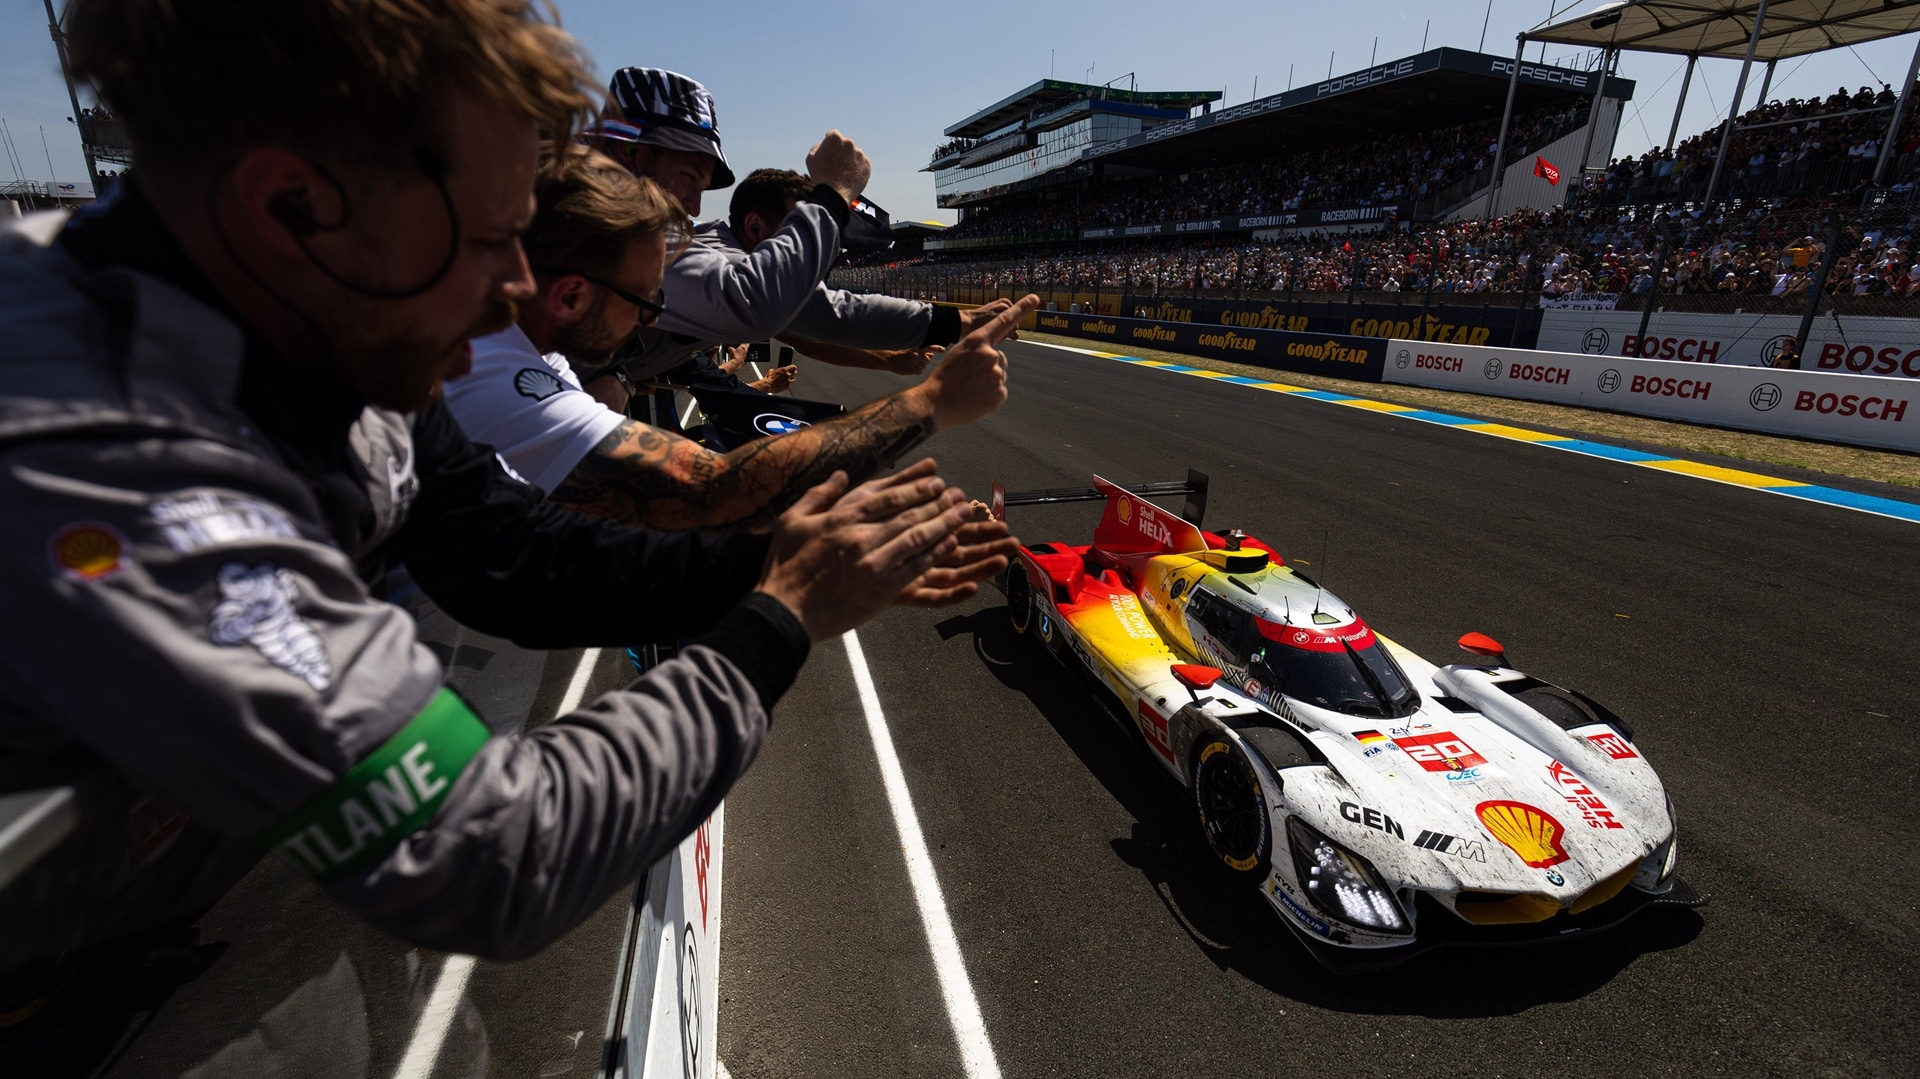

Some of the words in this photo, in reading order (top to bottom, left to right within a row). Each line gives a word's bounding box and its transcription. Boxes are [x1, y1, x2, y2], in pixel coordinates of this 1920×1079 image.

[1317, 59, 1414, 96] PORSCHE
[1491, 60, 1589, 88] PORSCHE
[1215, 97, 1281, 123] PORSCHE
[1146, 120, 1197, 141] PORSCHE
[1089, 139, 1128, 156] PORSCHE
[1175, 222, 1199, 232] RACBORN
[1239, 217, 1268, 228] RACEBORN
[1321, 209, 1360, 223] RACEBORN
[1082, 320, 1116, 335] GOODYEAR
[1133, 325, 1176, 342] GOODYEAR
[1350, 313, 1490, 346] GOODYEAR
[1198, 331, 1257, 351] GOODYEAR
[1287, 340, 1368, 365] GOODYEAR
[1621, 336, 1720, 363] BOSCH
[1415, 354, 1463, 372] BOSCH
[1817, 343, 1920, 378] BOSC
[1509, 363, 1570, 385] BOSCH
[1630, 375, 1711, 401] BOSCH
[1794, 390, 1907, 422] BOSCH
[1140, 506, 1155, 522] Shell
[1139, 518, 1174, 549] HELIX
[1119, 594, 1137, 611] 100%
[1127, 611, 1157, 639] POWER
[1140, 713, 1173, 752] 20
[1363, 747, 1382, 758] FIA
[1403, 740, 1475, 761] 20
[1446, 768, 1481, 780] WEC
[1545, 760, 1625, 830] HELIX
[283, 741, 449, 875] TLANE
[1565, 796, 1604, 829] Shell
[1340, 801, 1405, 841] GEN
[1281, 897, 1324, 931] MICHELIN
